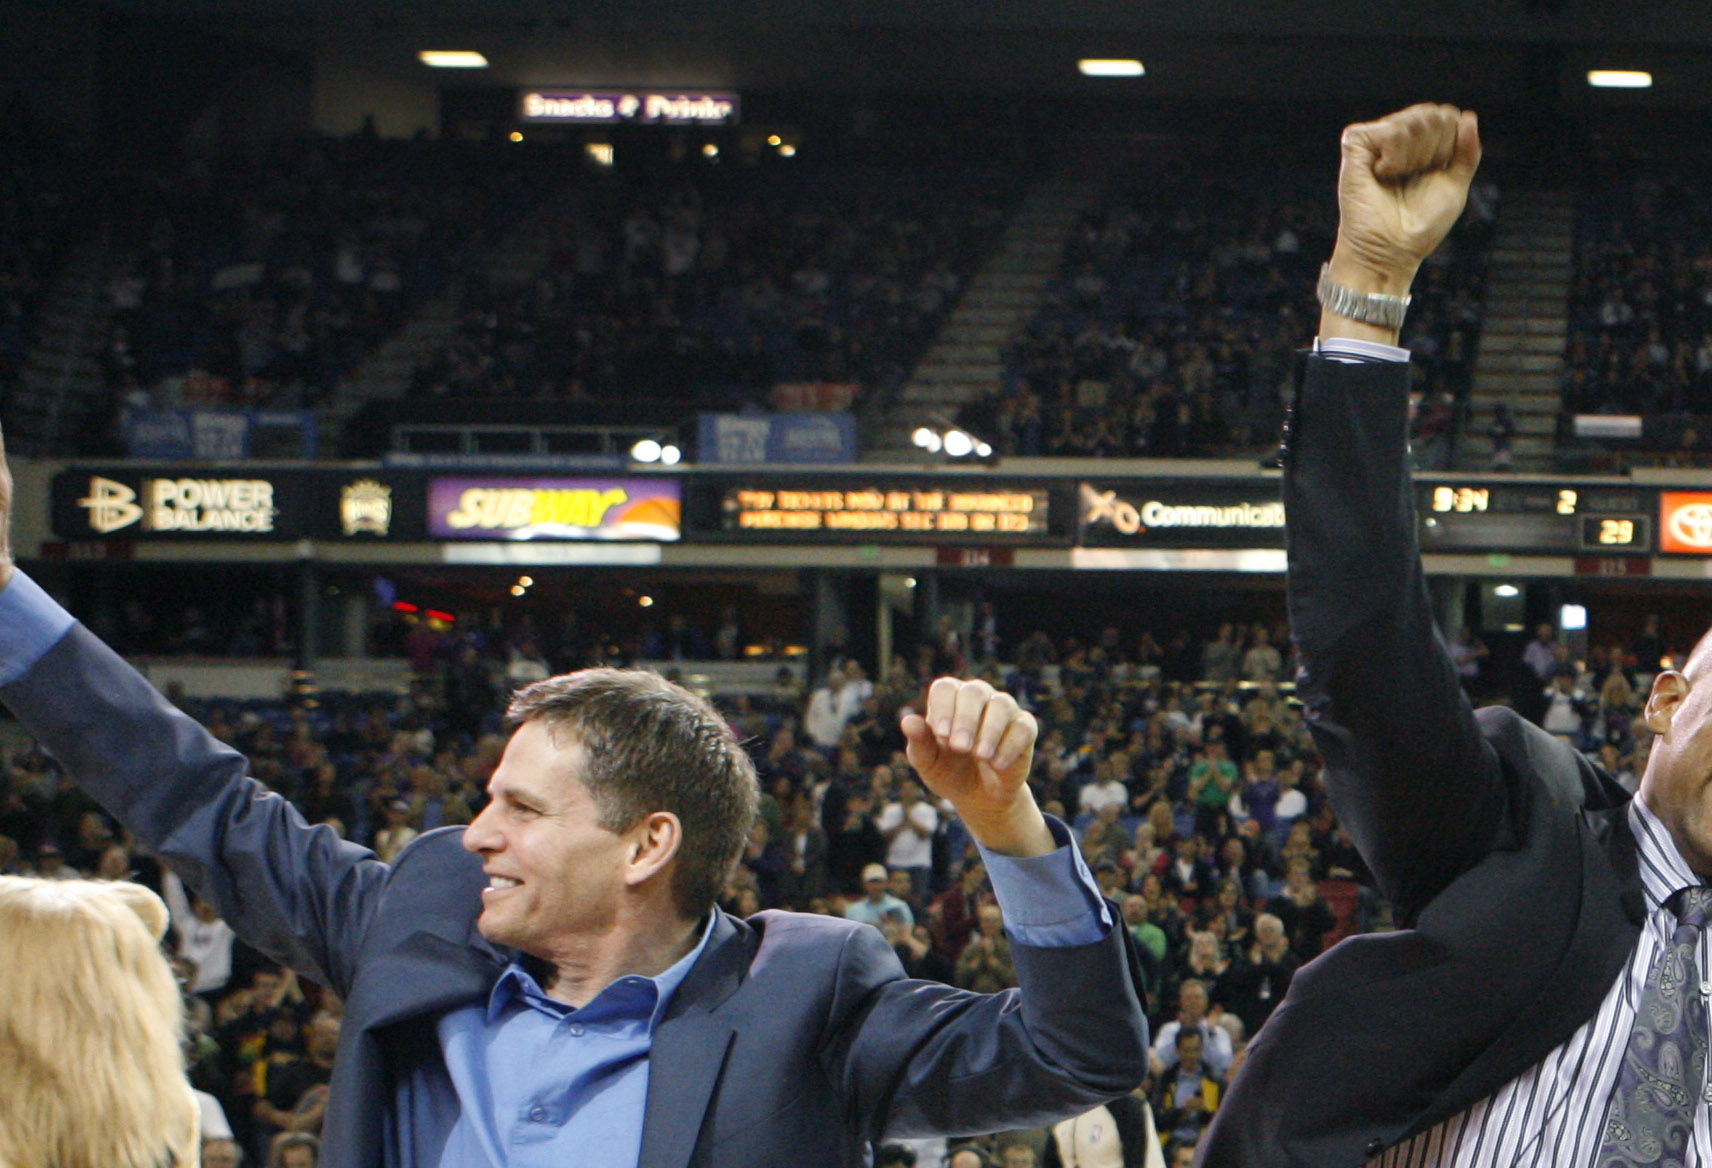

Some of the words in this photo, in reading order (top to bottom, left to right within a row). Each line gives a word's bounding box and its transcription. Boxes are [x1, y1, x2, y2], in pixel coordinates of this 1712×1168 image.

[524, 94, 614, 117] Snacks
[153, 479, 273, 509] POWER
[1557, 489, 1577, 514] 2
[153, 508, 274, 533] BALANCE
[447, 487, 628, 529] SUBWAY
